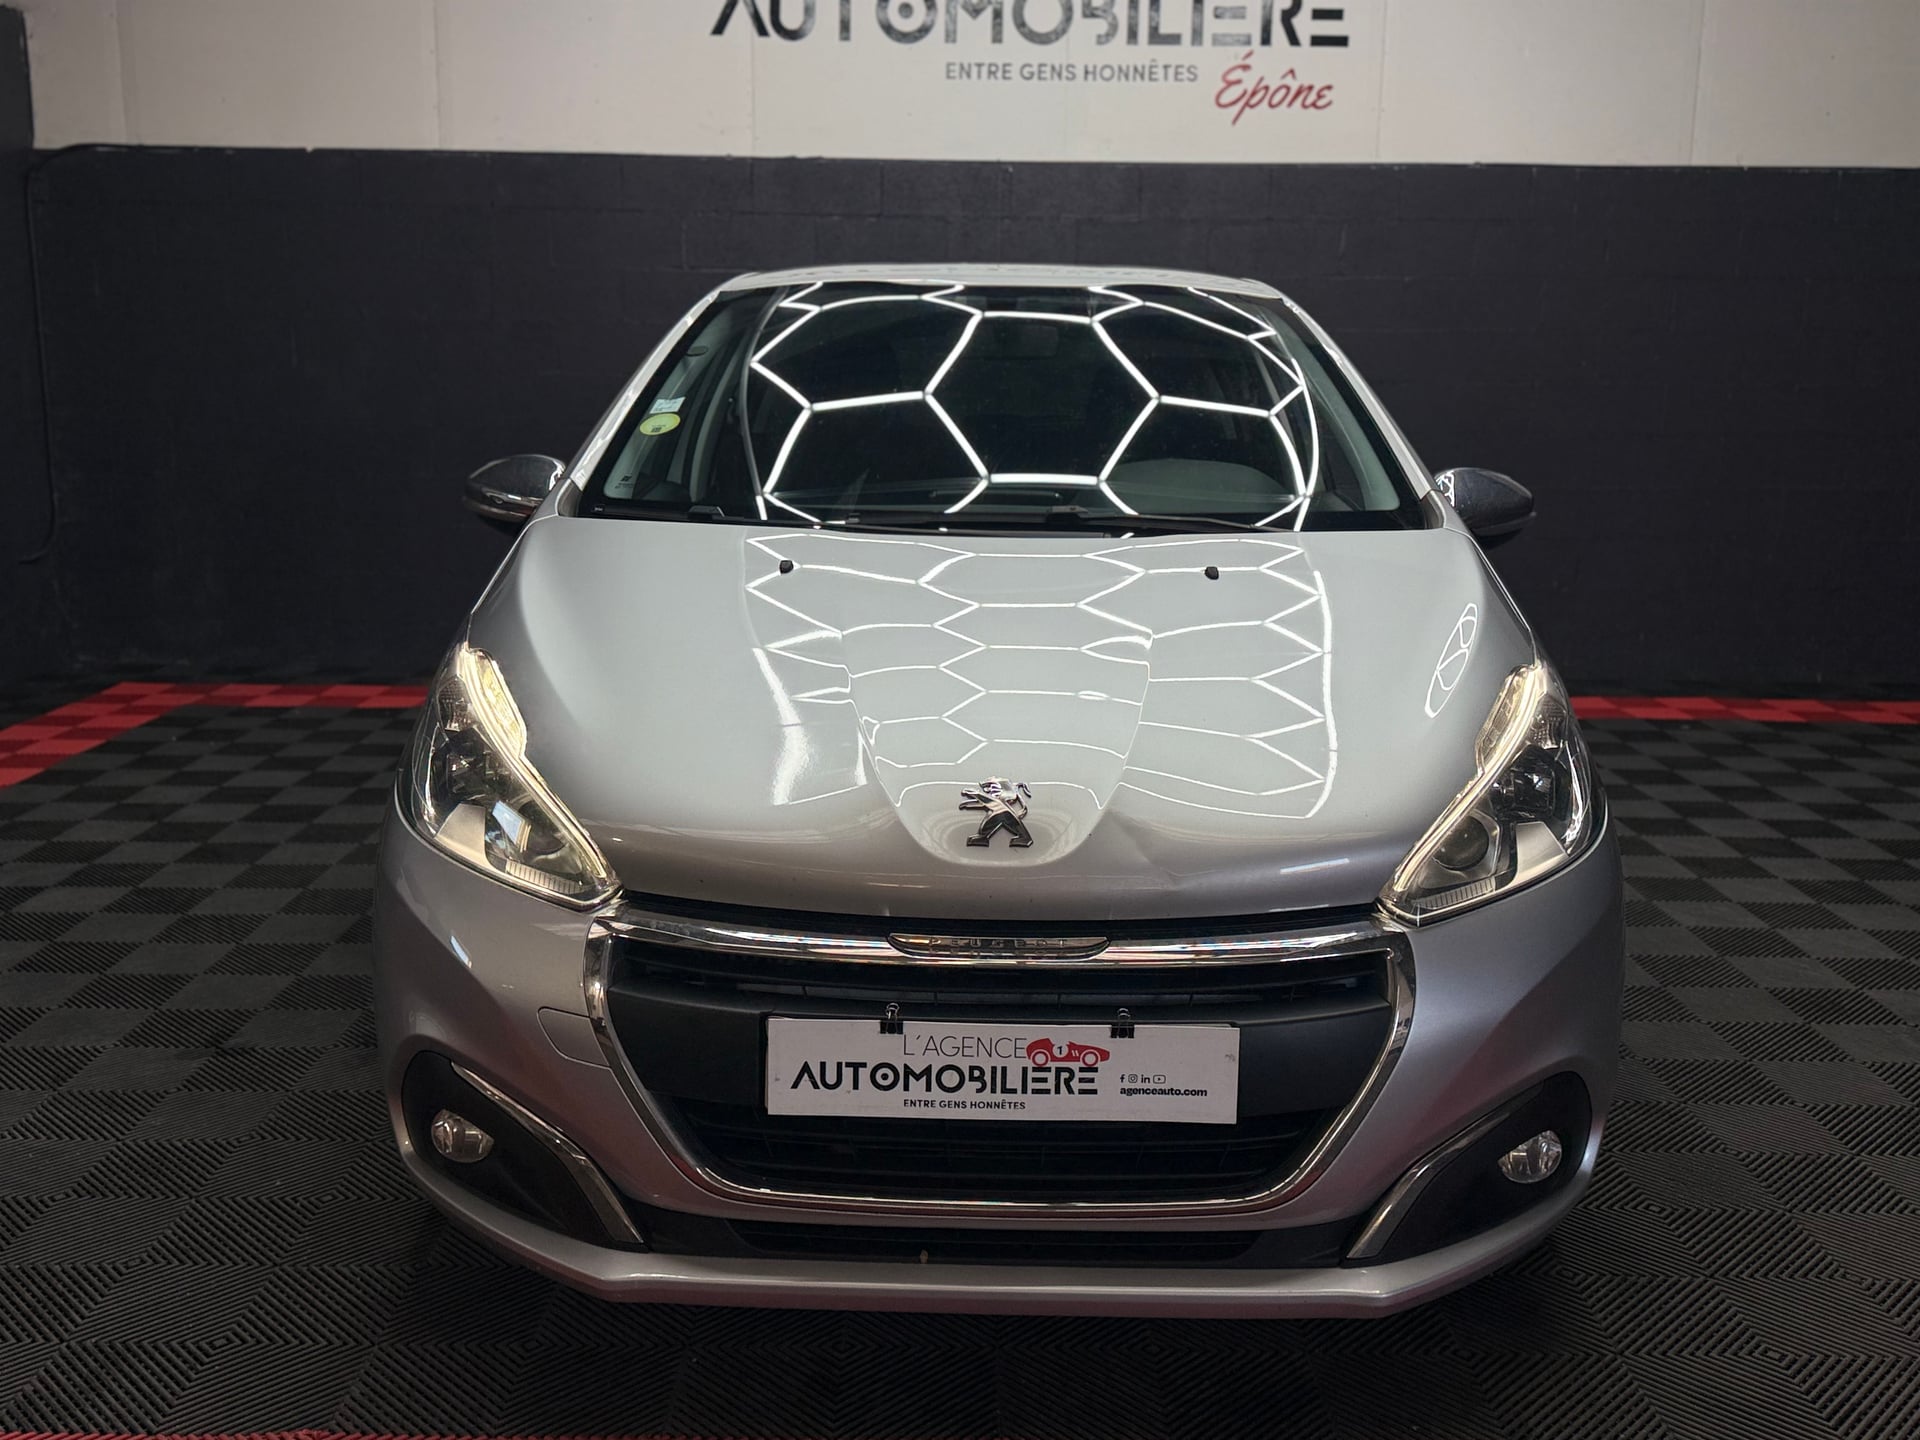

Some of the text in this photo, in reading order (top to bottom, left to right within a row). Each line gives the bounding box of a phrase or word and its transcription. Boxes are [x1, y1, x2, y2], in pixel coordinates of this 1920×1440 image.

[945, 59, 1199, 82] ENTRE GENS HONNÊTES
[1215, 50, 1333, 126] Épône
[903, 1034, 1027, 1059] L'AGENCE
[1120, 1087, 1207, 1096] agenceauto.com
[903, 1098, 1026, 1110] ENTRE GENS HONNÊTES
